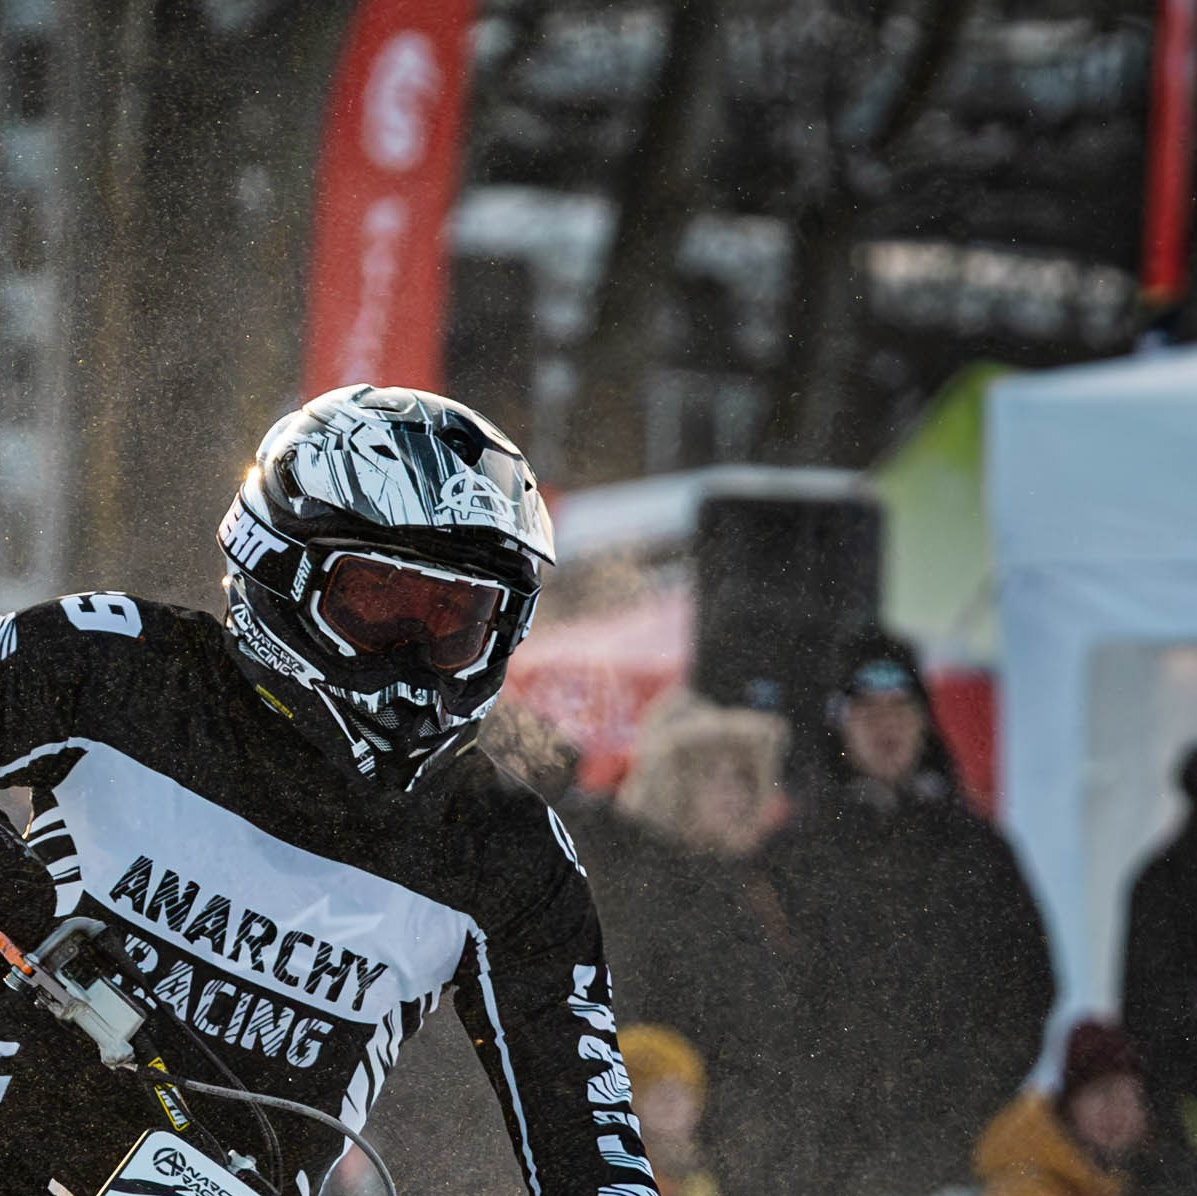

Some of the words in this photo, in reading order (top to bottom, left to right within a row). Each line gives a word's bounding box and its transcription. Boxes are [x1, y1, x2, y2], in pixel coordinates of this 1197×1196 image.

[290, 550, 312, 602] LEATT
[109, 855, 388, 1011] ANARCHY
[112, 933, 334, 1067] RACING
